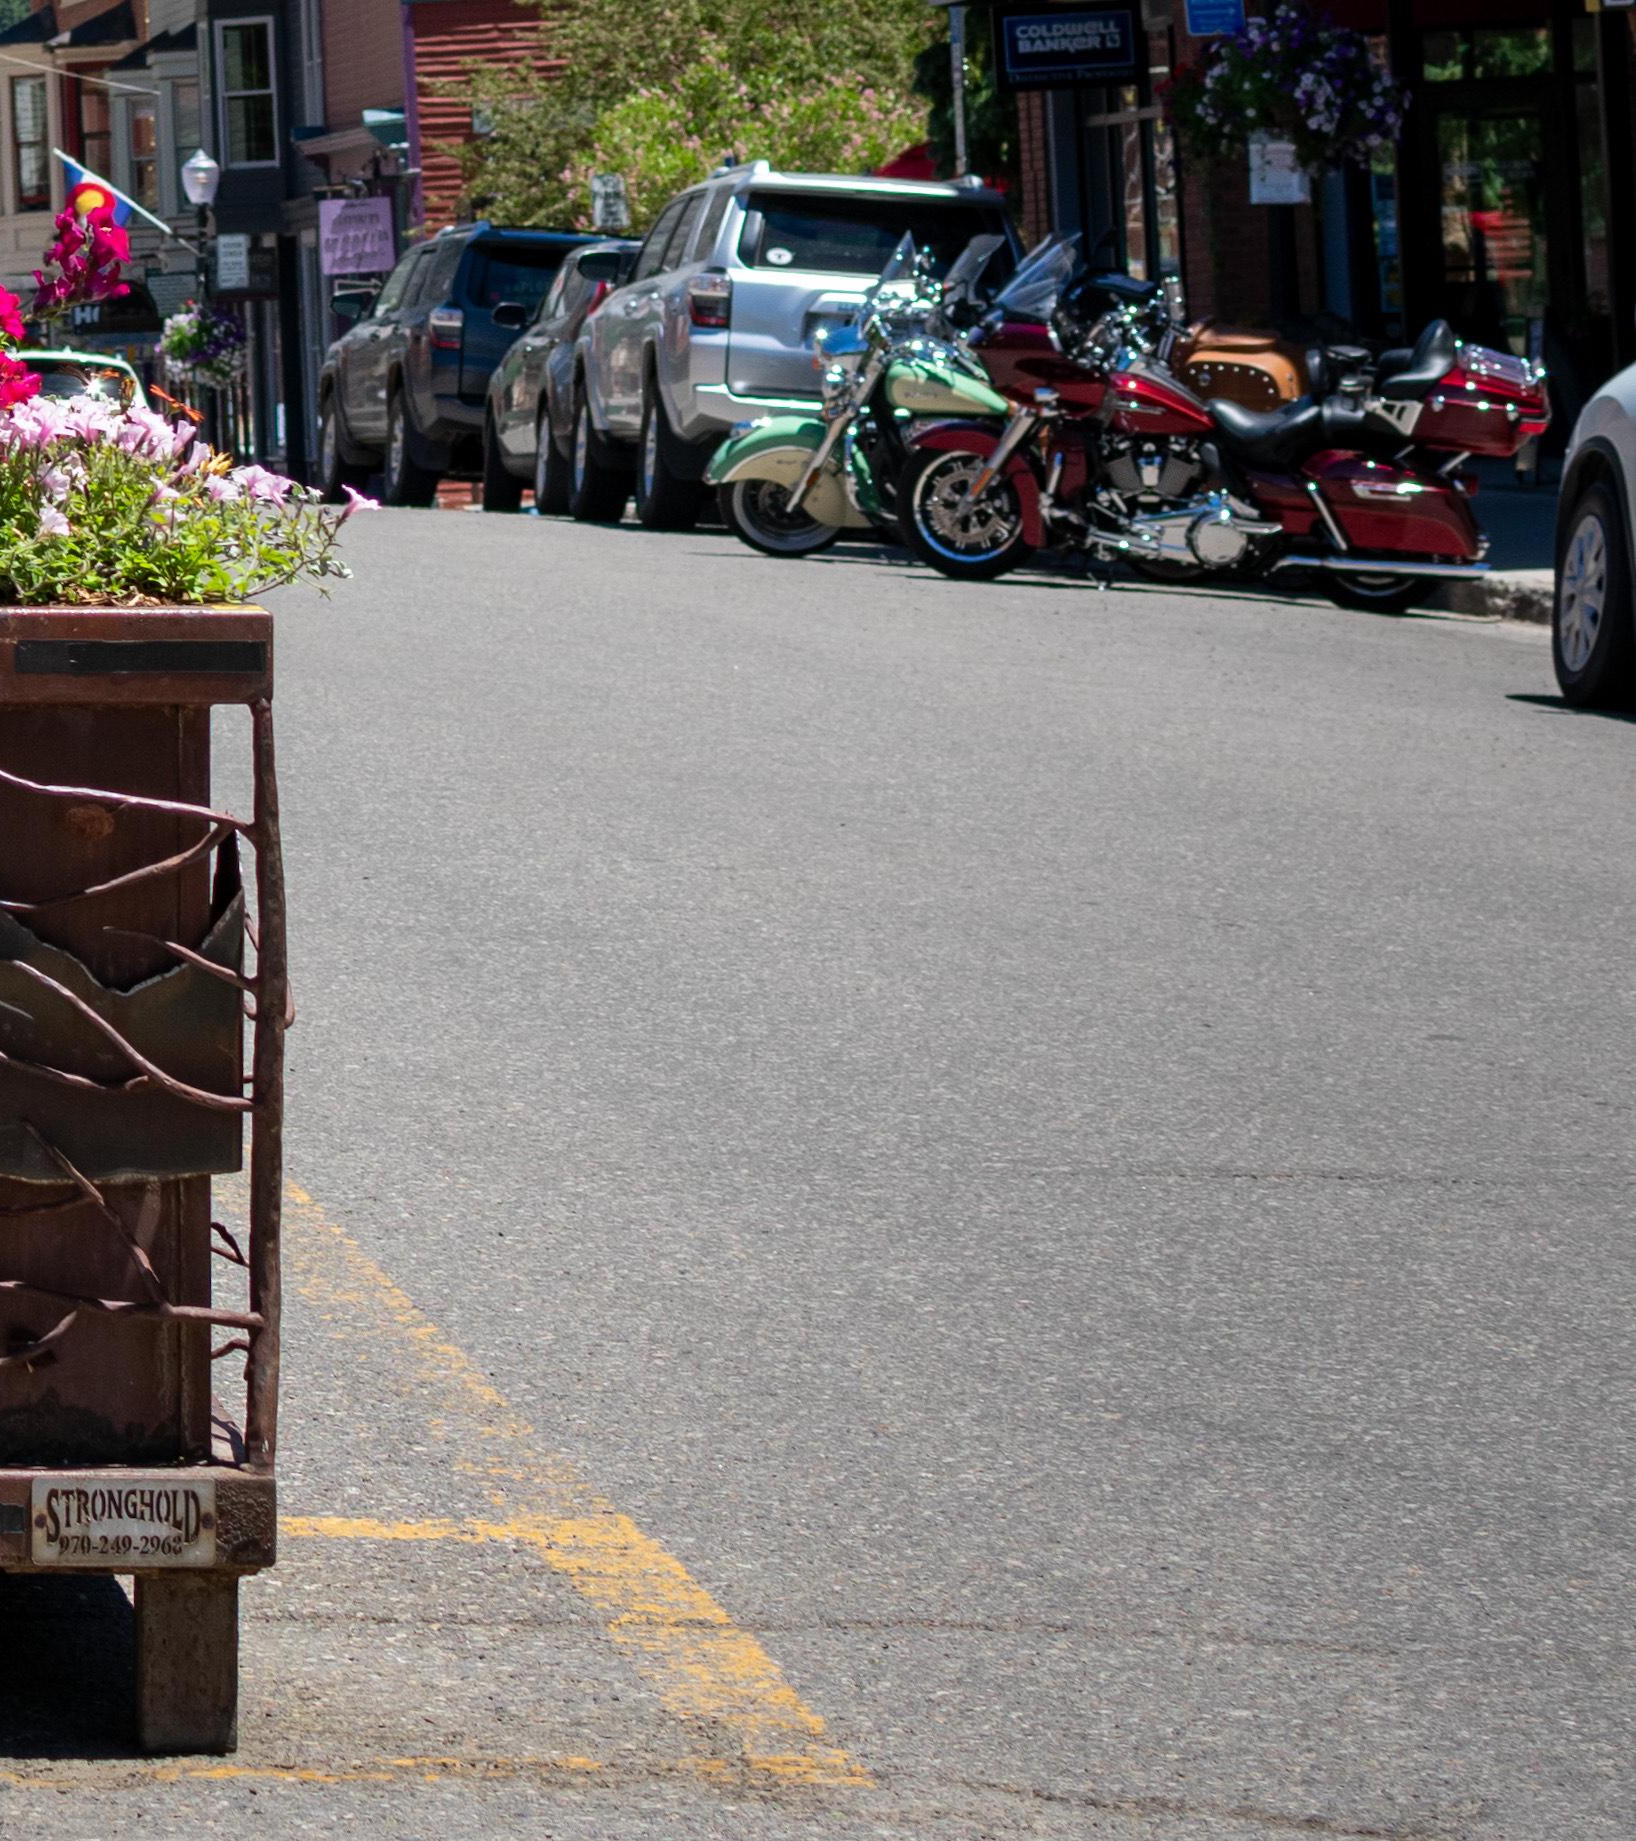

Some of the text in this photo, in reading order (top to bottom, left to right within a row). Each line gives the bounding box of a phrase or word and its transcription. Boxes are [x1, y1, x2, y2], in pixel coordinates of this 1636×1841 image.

[1015, 20, 1121, 39] COLDWELL
[1018, 35, 1102, 54] BANKER
[45, 1486, 201, 1544] STRONGHOLD
